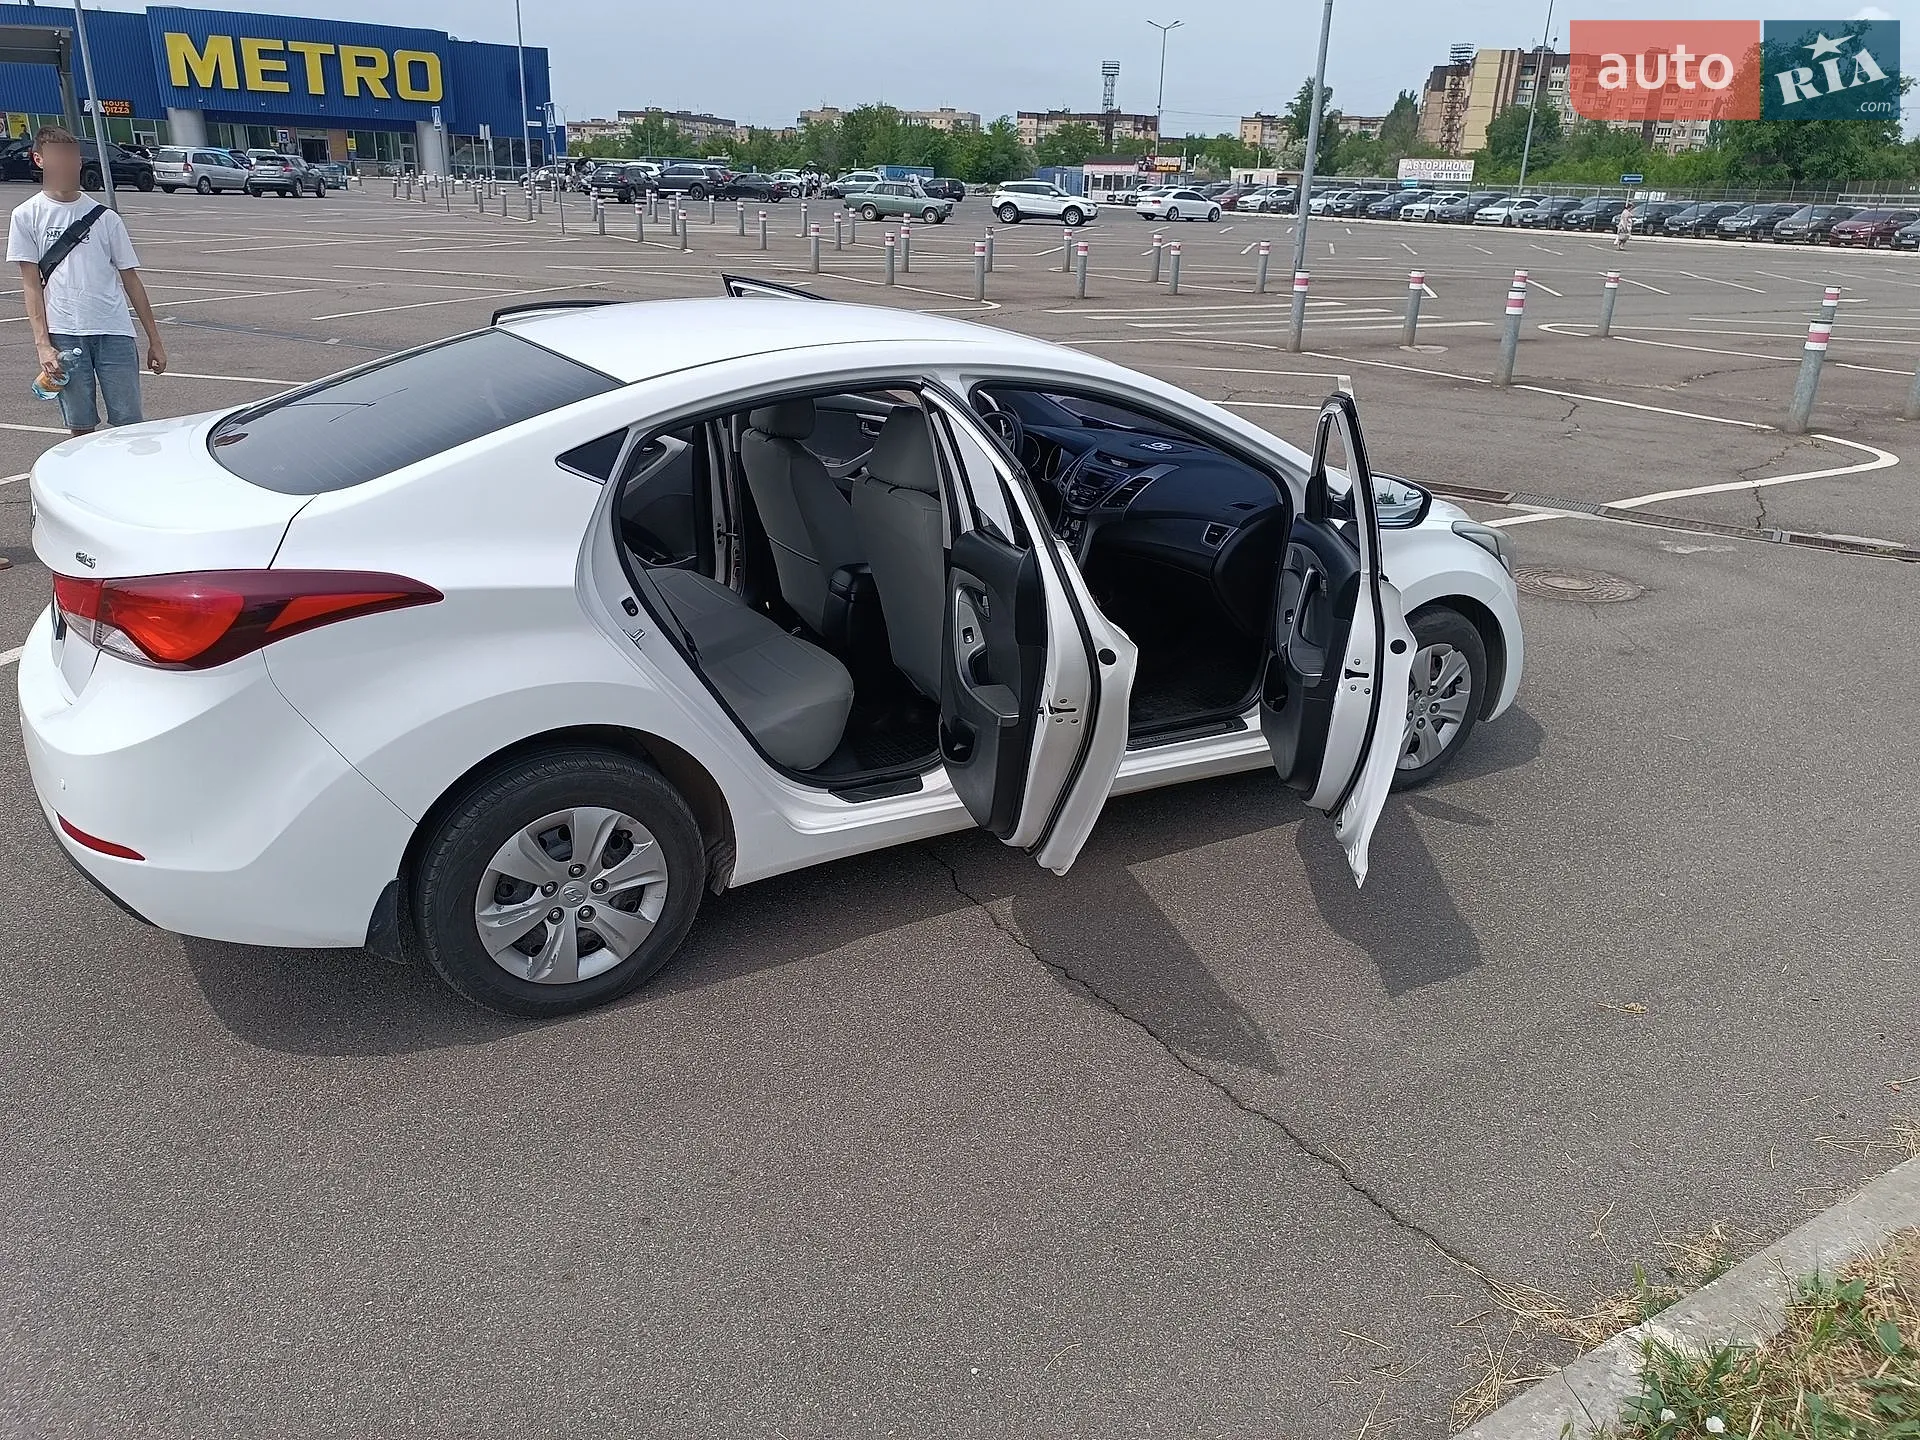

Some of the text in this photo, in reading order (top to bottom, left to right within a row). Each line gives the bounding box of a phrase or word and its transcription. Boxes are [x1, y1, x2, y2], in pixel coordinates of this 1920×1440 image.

[163, 32, 444, 103] METRO
[102, 100, 130, 108] HOUSE
[1406, 160, 1467, 171] АВТОРИНОК
